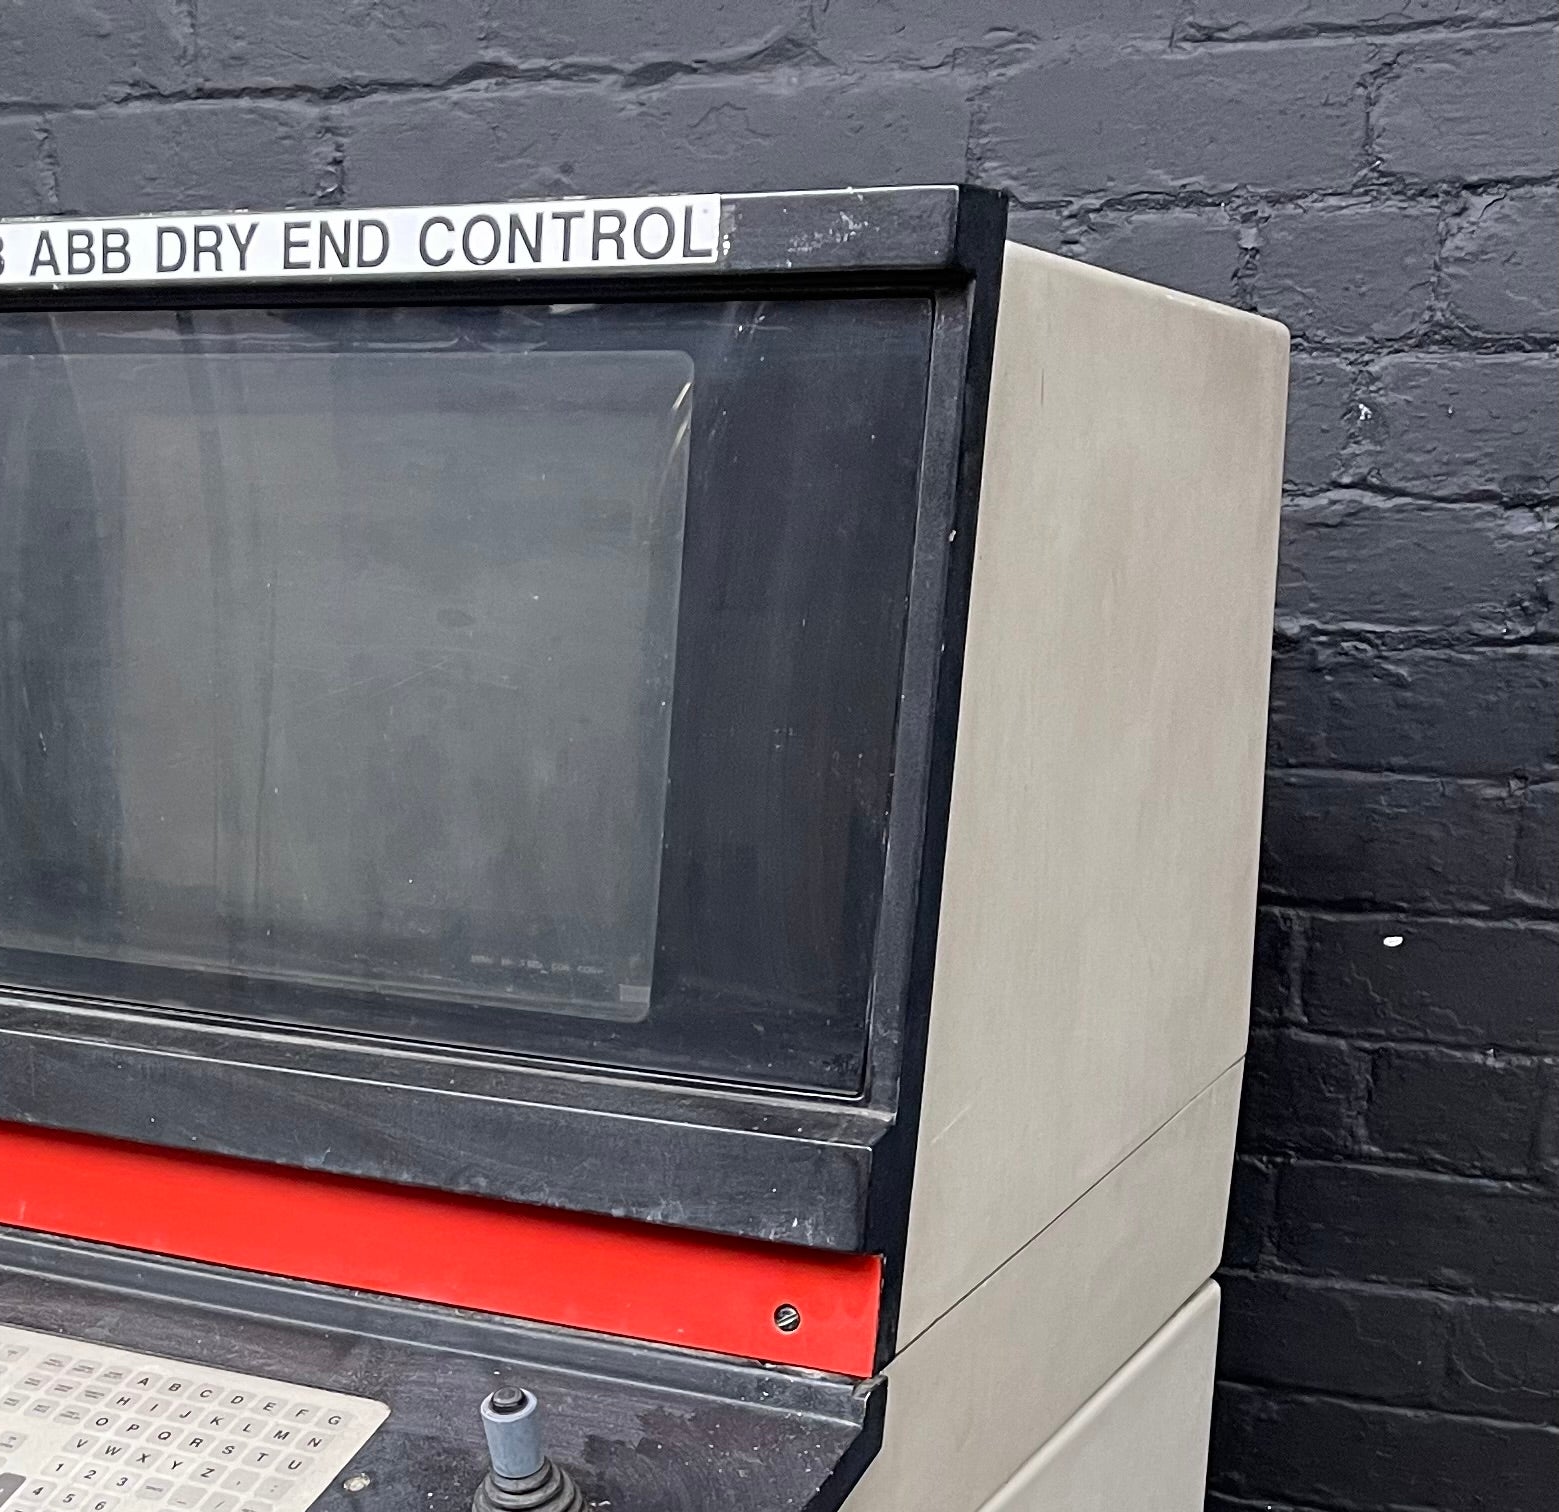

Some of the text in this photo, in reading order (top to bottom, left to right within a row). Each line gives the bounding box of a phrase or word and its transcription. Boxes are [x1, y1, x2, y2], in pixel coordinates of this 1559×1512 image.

[29, 227, 132, 277] ABB
[155, 222, 261, 275] DRY
[283, 218, 390, 271] END
[418, 204, 713, 267] CONTROL
[116, 1396, 322, 1447] H I J K L M N
[137, 1377, 341, 1425] A B C D E F G
[76, 1439, 87, 1448] V
[105, 1445, 122, 1456] W
[137, 1453, 148, 1463] X
[171, 1461, 182, 1470] Y
[200, 1468, 215, 1478] Z
[95, 1417, 302, 1470] O P Q R S T U
[32, 1487, 44, 1495] 4
[62, 1493, 74, 1503] 5
[94, 1501, 106, 1510] 6
[55, 1463, 128, 1486] 1 2 3
